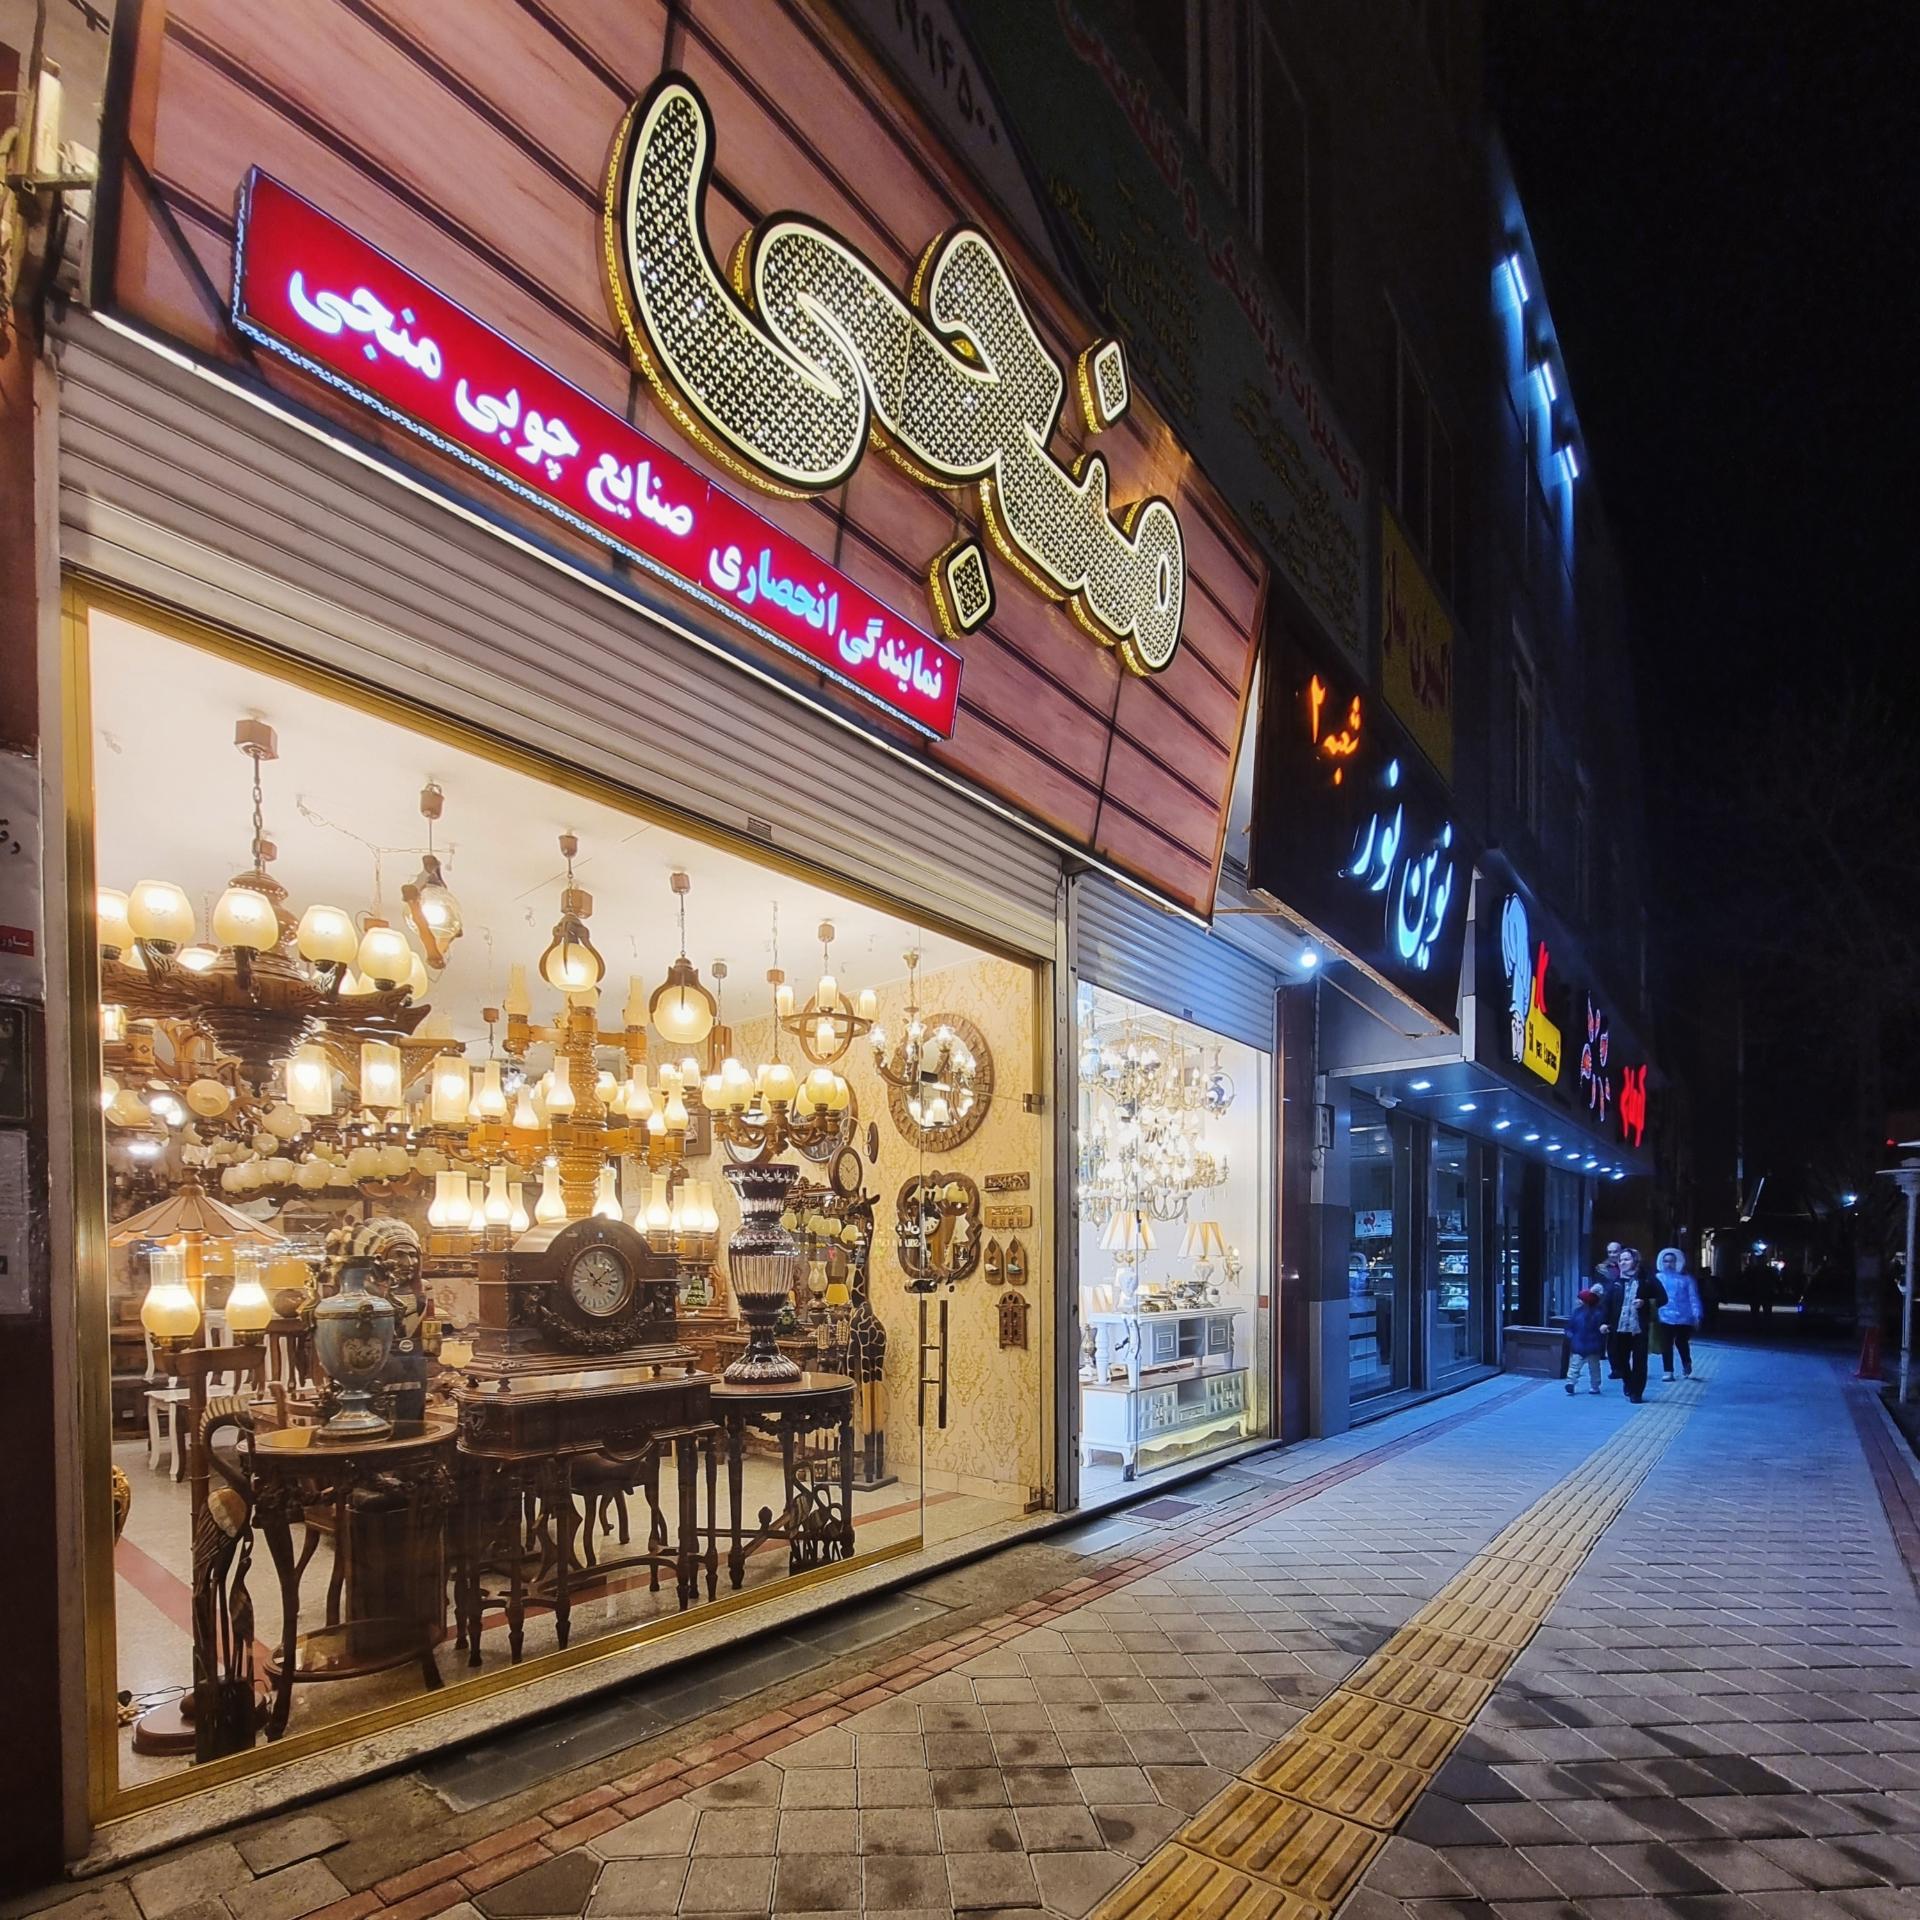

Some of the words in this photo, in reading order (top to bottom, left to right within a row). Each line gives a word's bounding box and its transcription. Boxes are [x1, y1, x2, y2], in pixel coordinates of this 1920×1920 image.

[288, 271, 442, 380] منجی
[618, 74, 1187, 675] منجی
[454, 378, 580, 482] چوبی
[586, 453, 694, 537] صنایع
[708, 546, 838, 638] انحصاری
[838, 618, 944, 700] نمایندگی
[1308, 674, 1327, 744] ۲
[1322, 696, 1361, 786] شعبه
